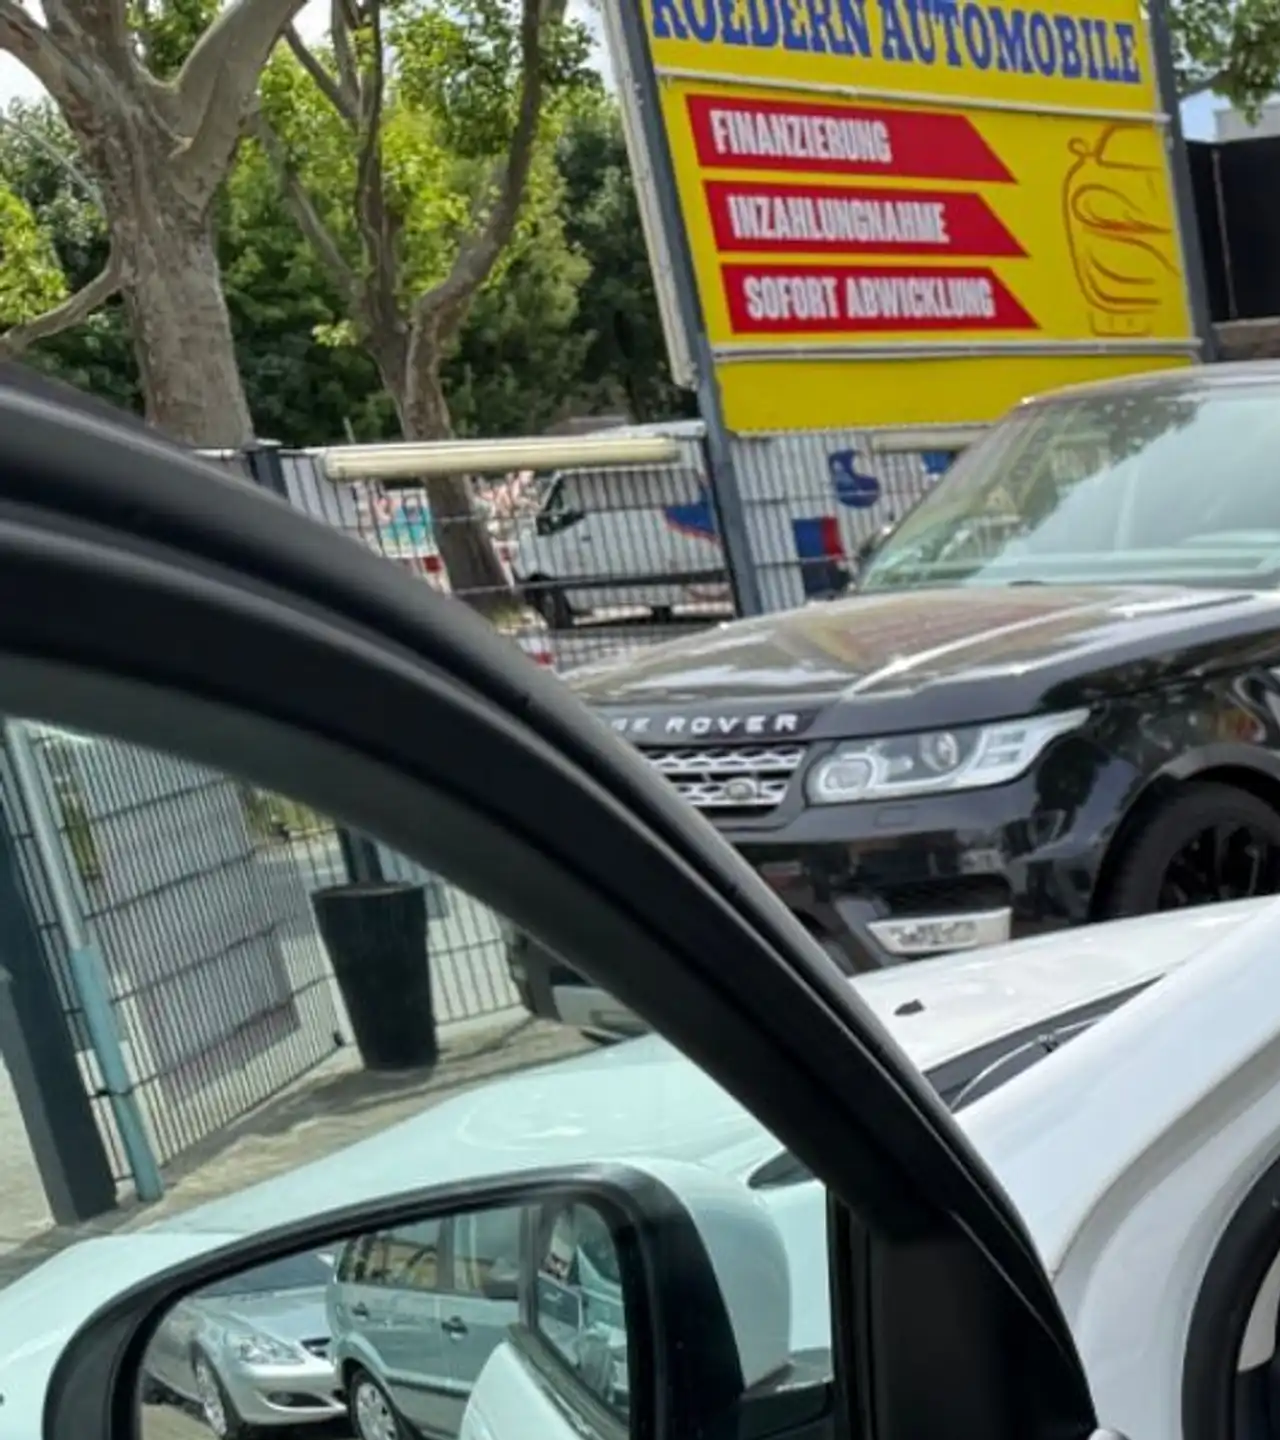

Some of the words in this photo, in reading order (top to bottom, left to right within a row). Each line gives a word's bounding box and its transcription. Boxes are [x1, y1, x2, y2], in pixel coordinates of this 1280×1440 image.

[878, 0, 1141, 84] AUTOMOBILE
[709, 108, 892, 164] FINANZIERUNG
[727, 195, 951, 244] INZAHLUNGNAHME
[743, 276, 840, 320] SOFORT
[845, 276, 996, 319] ABWICKLUNG
[664, 713, 799, 734] ROVER
